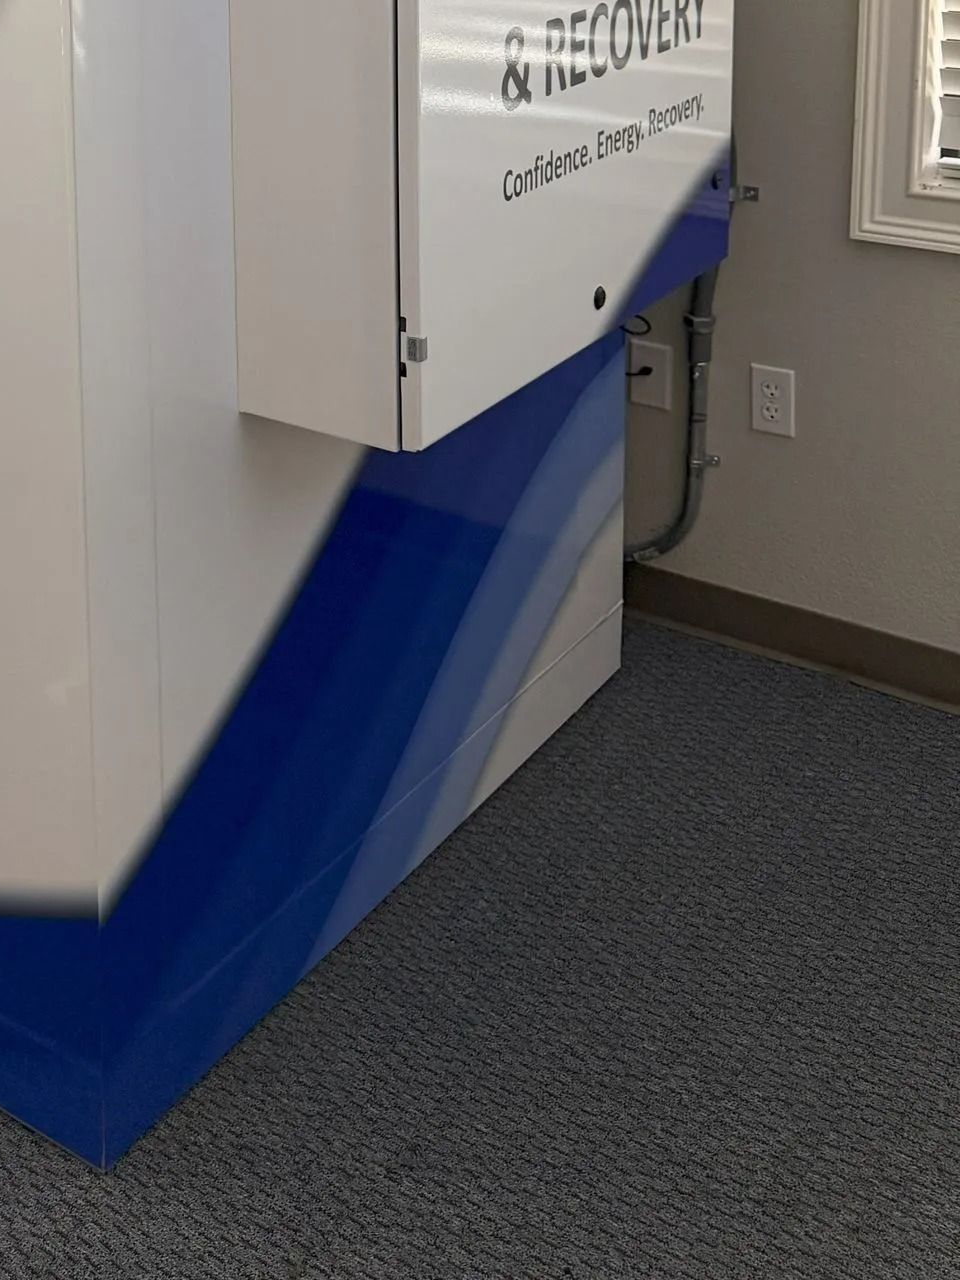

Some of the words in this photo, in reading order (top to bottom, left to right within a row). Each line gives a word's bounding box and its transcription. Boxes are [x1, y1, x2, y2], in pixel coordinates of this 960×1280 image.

[501, 26, 532, 112] &
[503, 144, 593, 202] Confidence.
[596, 120, 645, 160] Energy.
[648, 92, 705, 136] Recovery.
